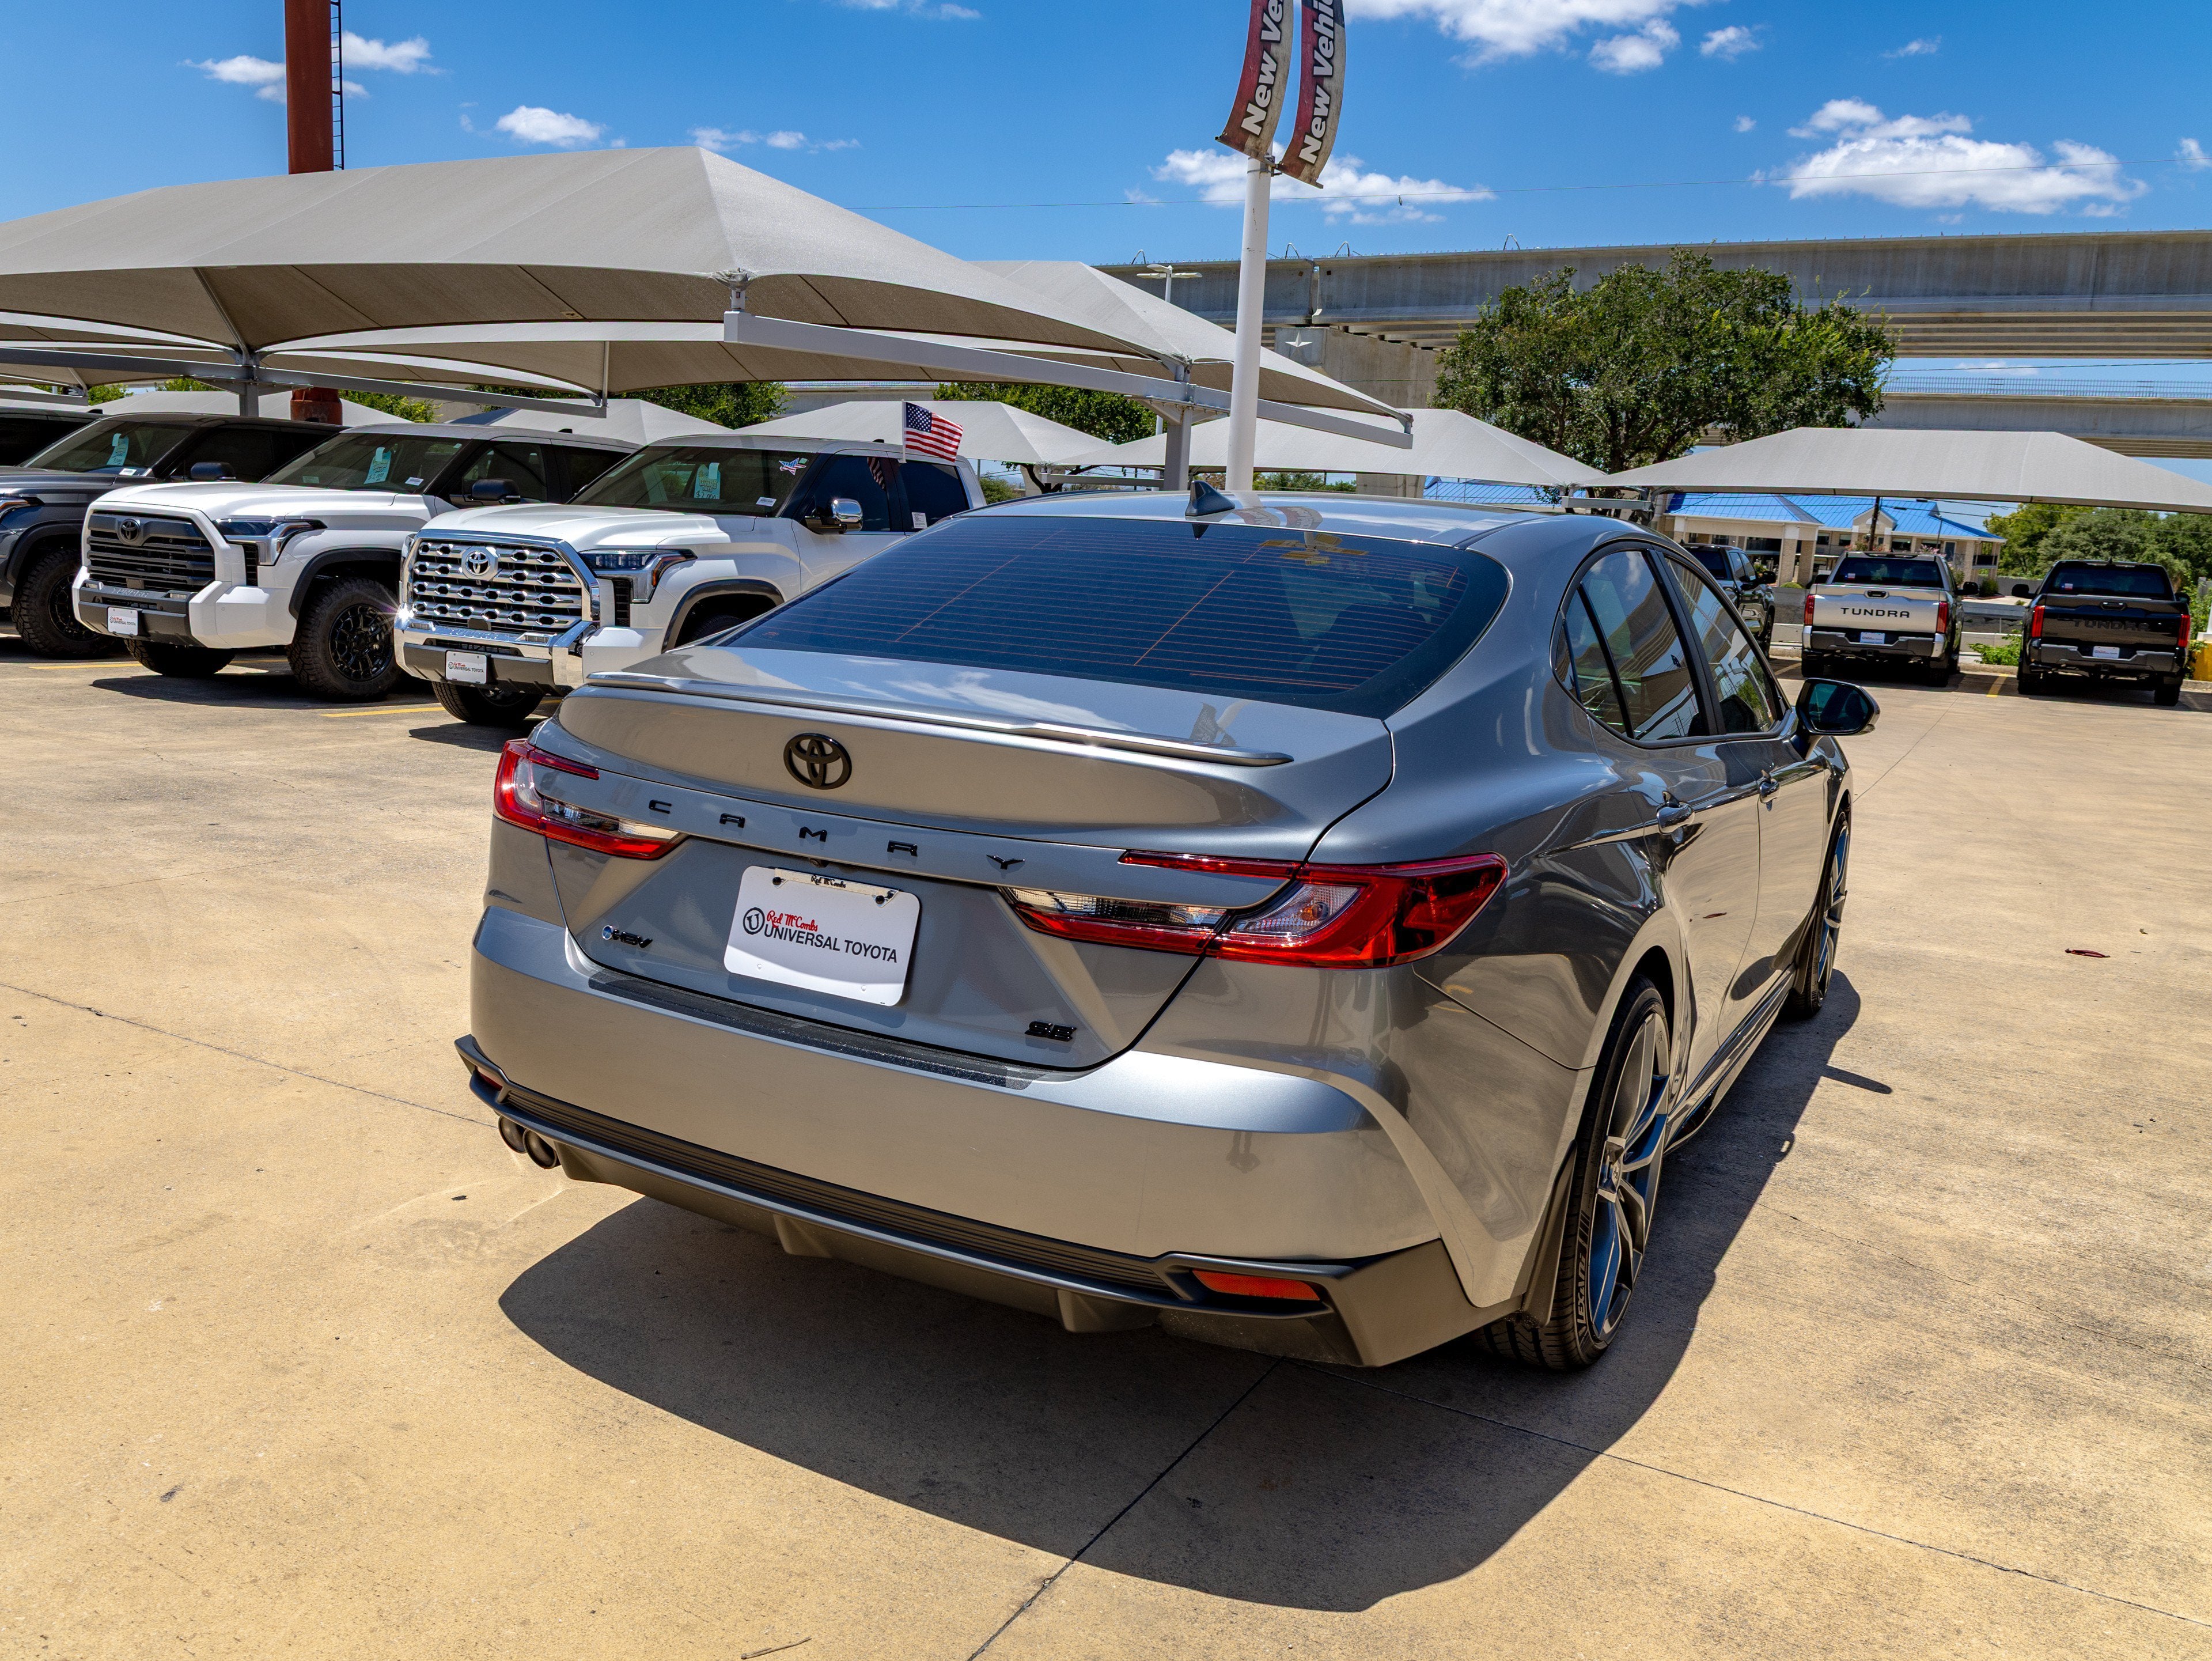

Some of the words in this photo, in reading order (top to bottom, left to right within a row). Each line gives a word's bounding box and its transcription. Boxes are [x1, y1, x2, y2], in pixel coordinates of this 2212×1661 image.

[1241, 50, 1277, 136] New
[1260, 0, 1283, 41] Ve
[1298, 85, 1331, 164] New
[1840, 607, 1910, 618] TUNDRA
[2074, 619, 2151, 631] TUNDRA
[648, 799, 1025, 869] CAMRY
[767, 910, 783, 928] Red
[785, 913, 818, 932] McCombs
[764, 924, 840, 952] UNIVERSAL
[844, 939, 897, 963] TOYOTA
[1025, 1020, 1077, 1042] SE
